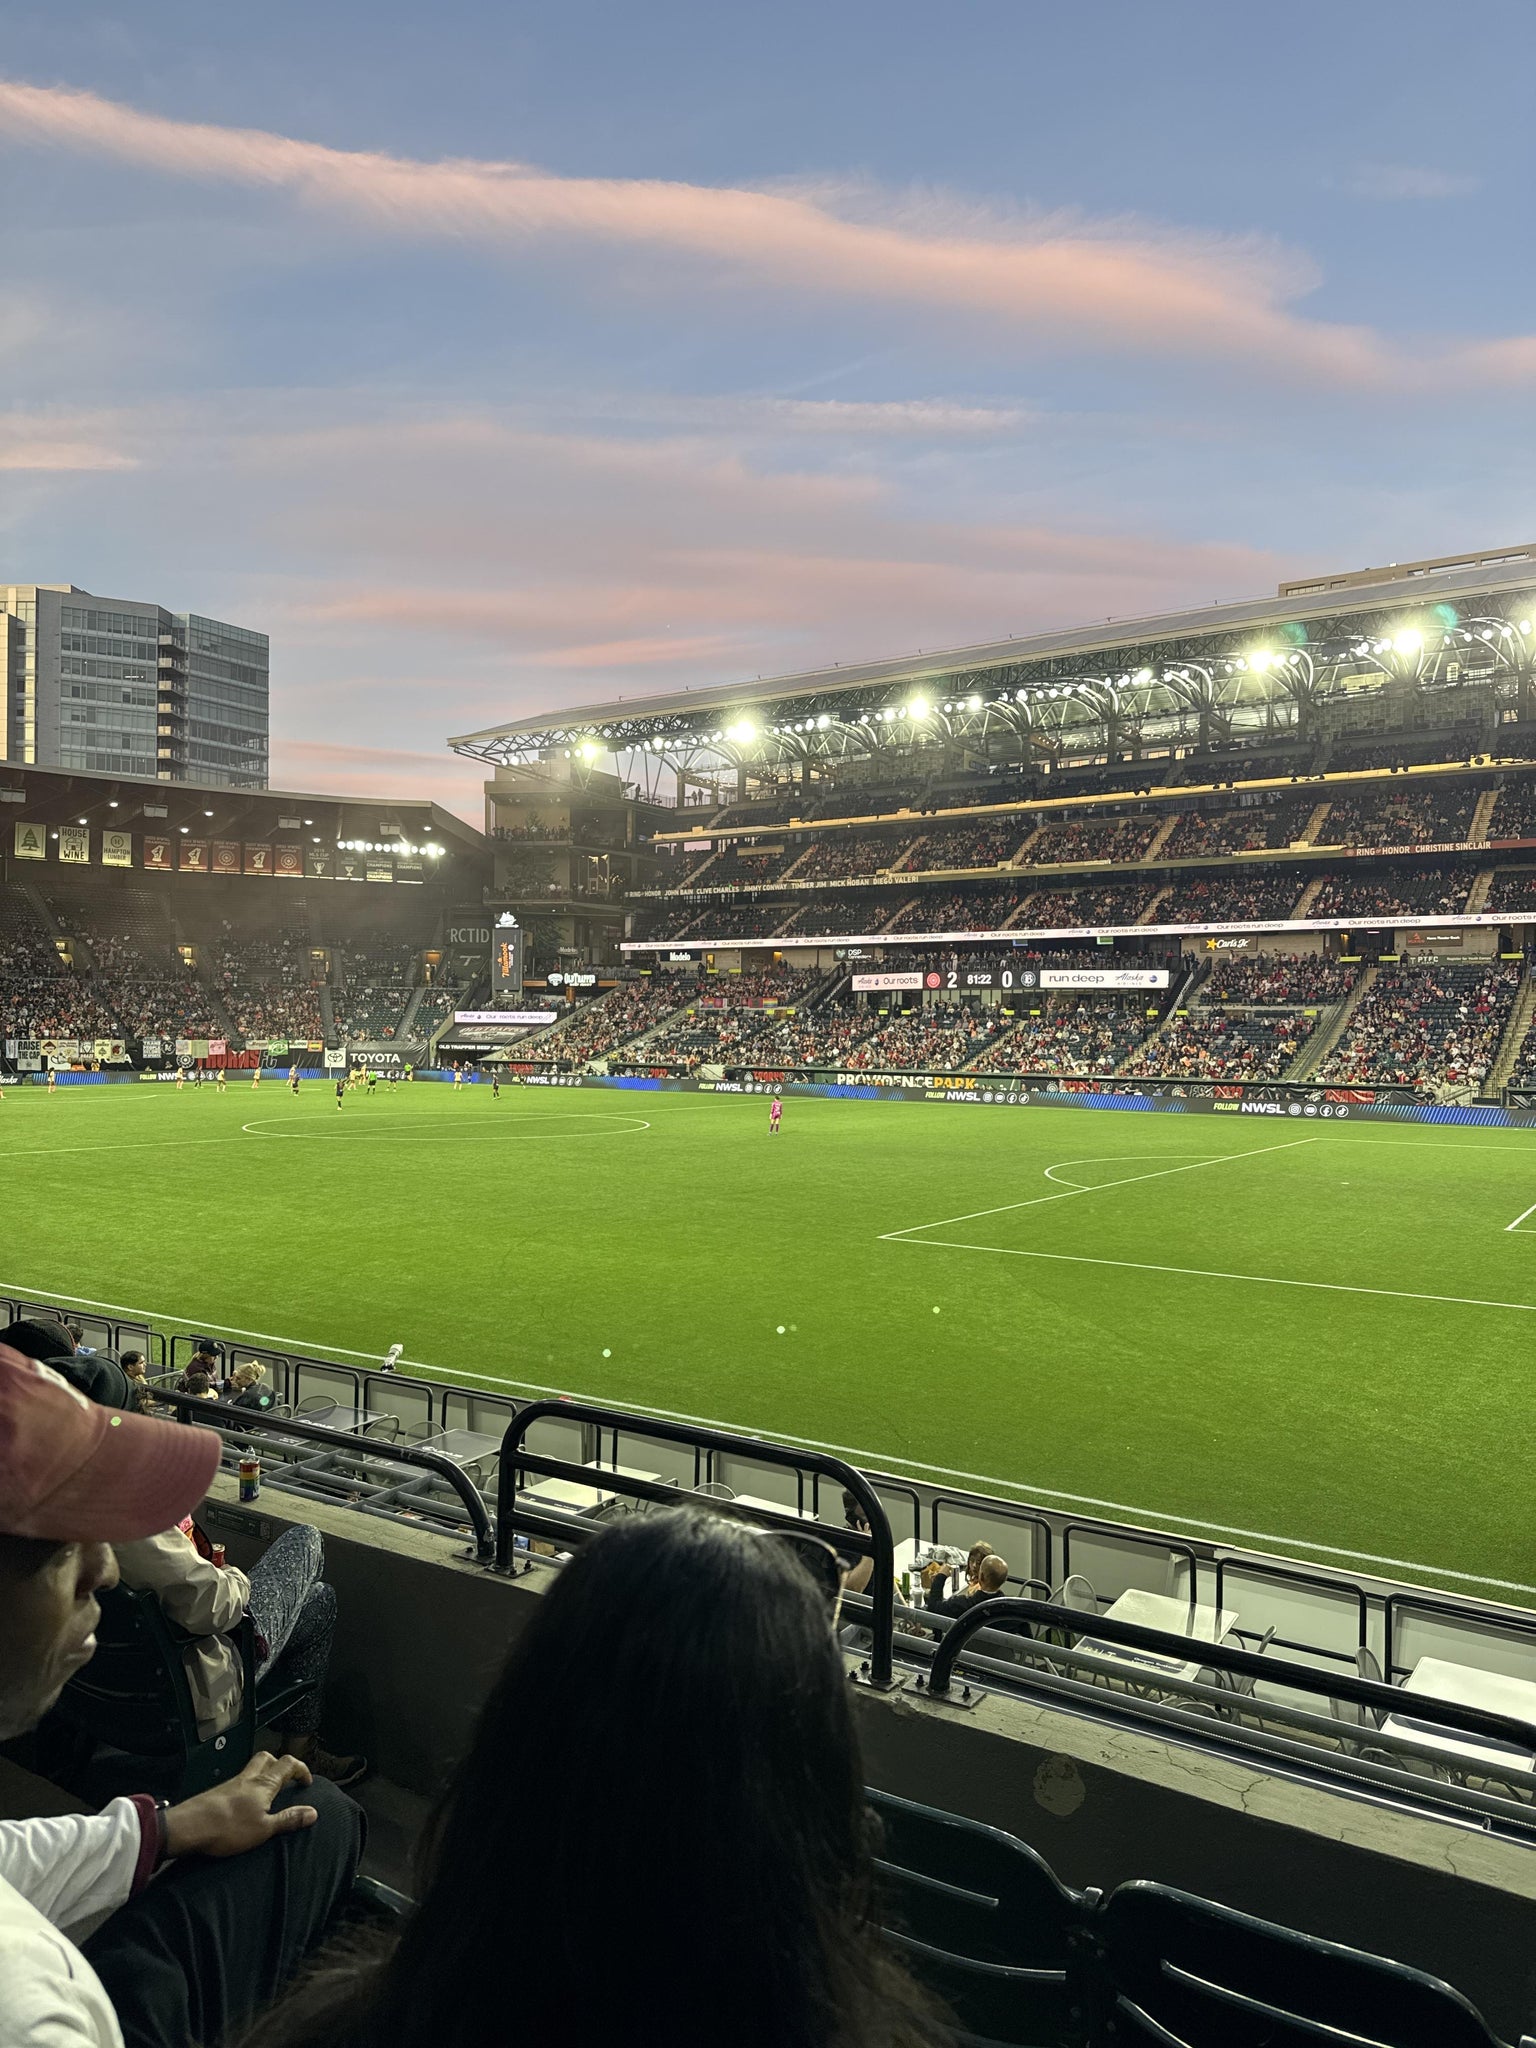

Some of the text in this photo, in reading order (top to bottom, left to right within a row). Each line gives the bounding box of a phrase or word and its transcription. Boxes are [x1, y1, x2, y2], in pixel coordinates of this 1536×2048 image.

[62, 828, 87, 838] HOUSE
[1382, 846, 1410, 854] HONOR
[1416, 843, 1454, 852] CHRISTINE
[1456, 842, 1491, 850] SINCLAIR
[64, 850, 85, 860] WINE
[873, 876, 892, 885] DIEGO
[894, 876, 918, 884] VALERI
[450, 928, 490, 942] RCTID
[1216, 939, 1236, 948] Carl's
[500, 942, 510, 978] Tillamook
[670, 952, 691, 962] Modelo
[947, 970, 1012, 988] 2 81:22 0
[1072, 974, 1104, 984] deep
[1114, 972, 1144, 982] Alaska
[18, 1041, 40, 1050] RAISE
[18, 1051, 40, 1060] THE CAP
[350, 1053, 400, 1064] TOYOTA
[0, 1076, 18, 1084] laska
[526, 1076, 550, 1084] NWSL
[934, 1076, 976, 1090] PARK
[716, 1082, 743, 1092] NWSL
[947, 1091, 980, 1100] NWSL
[1213, 1102, 1286, 1114] FOLLOW NWSL
